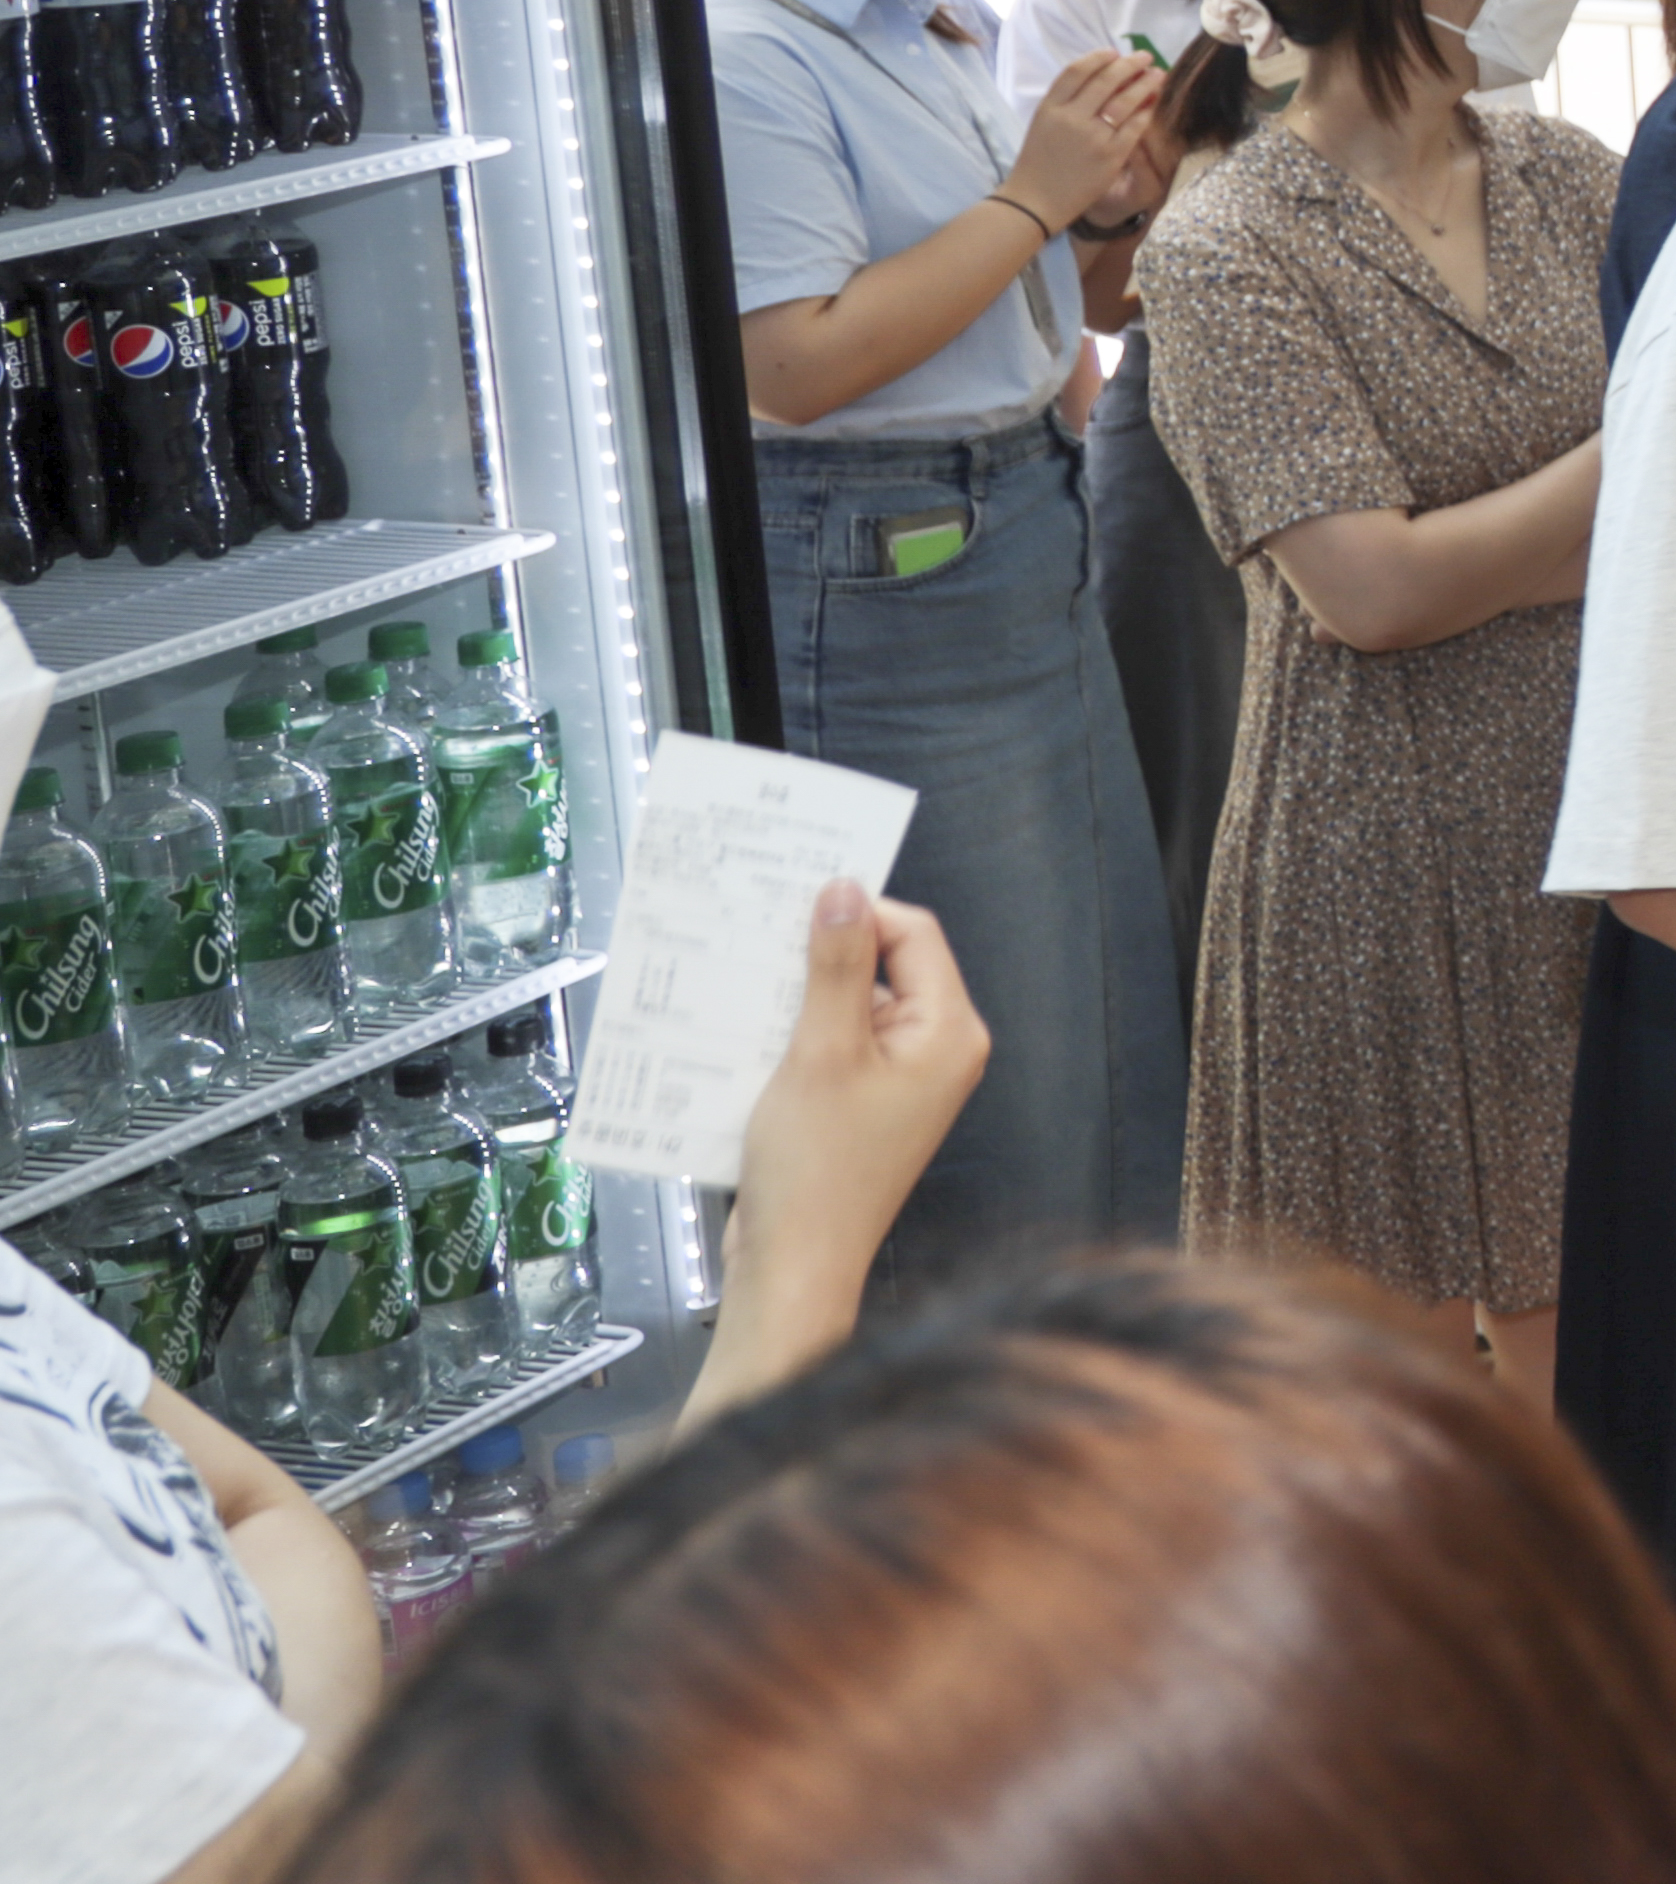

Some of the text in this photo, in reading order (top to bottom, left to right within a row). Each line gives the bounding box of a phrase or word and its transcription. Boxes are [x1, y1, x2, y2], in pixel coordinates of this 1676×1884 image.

[172, 320, 197, 369] pepsi
[250, 298, 274, 347] pepsi
[3, 340, 24, 390] pepsi
[373, 790, 440, 909] Chilsung
[15, 914, 102, 1040] Chilsung
[65, 953, 98, 1014] Cider
[423, 1181, 494, 1298] Chilsung
